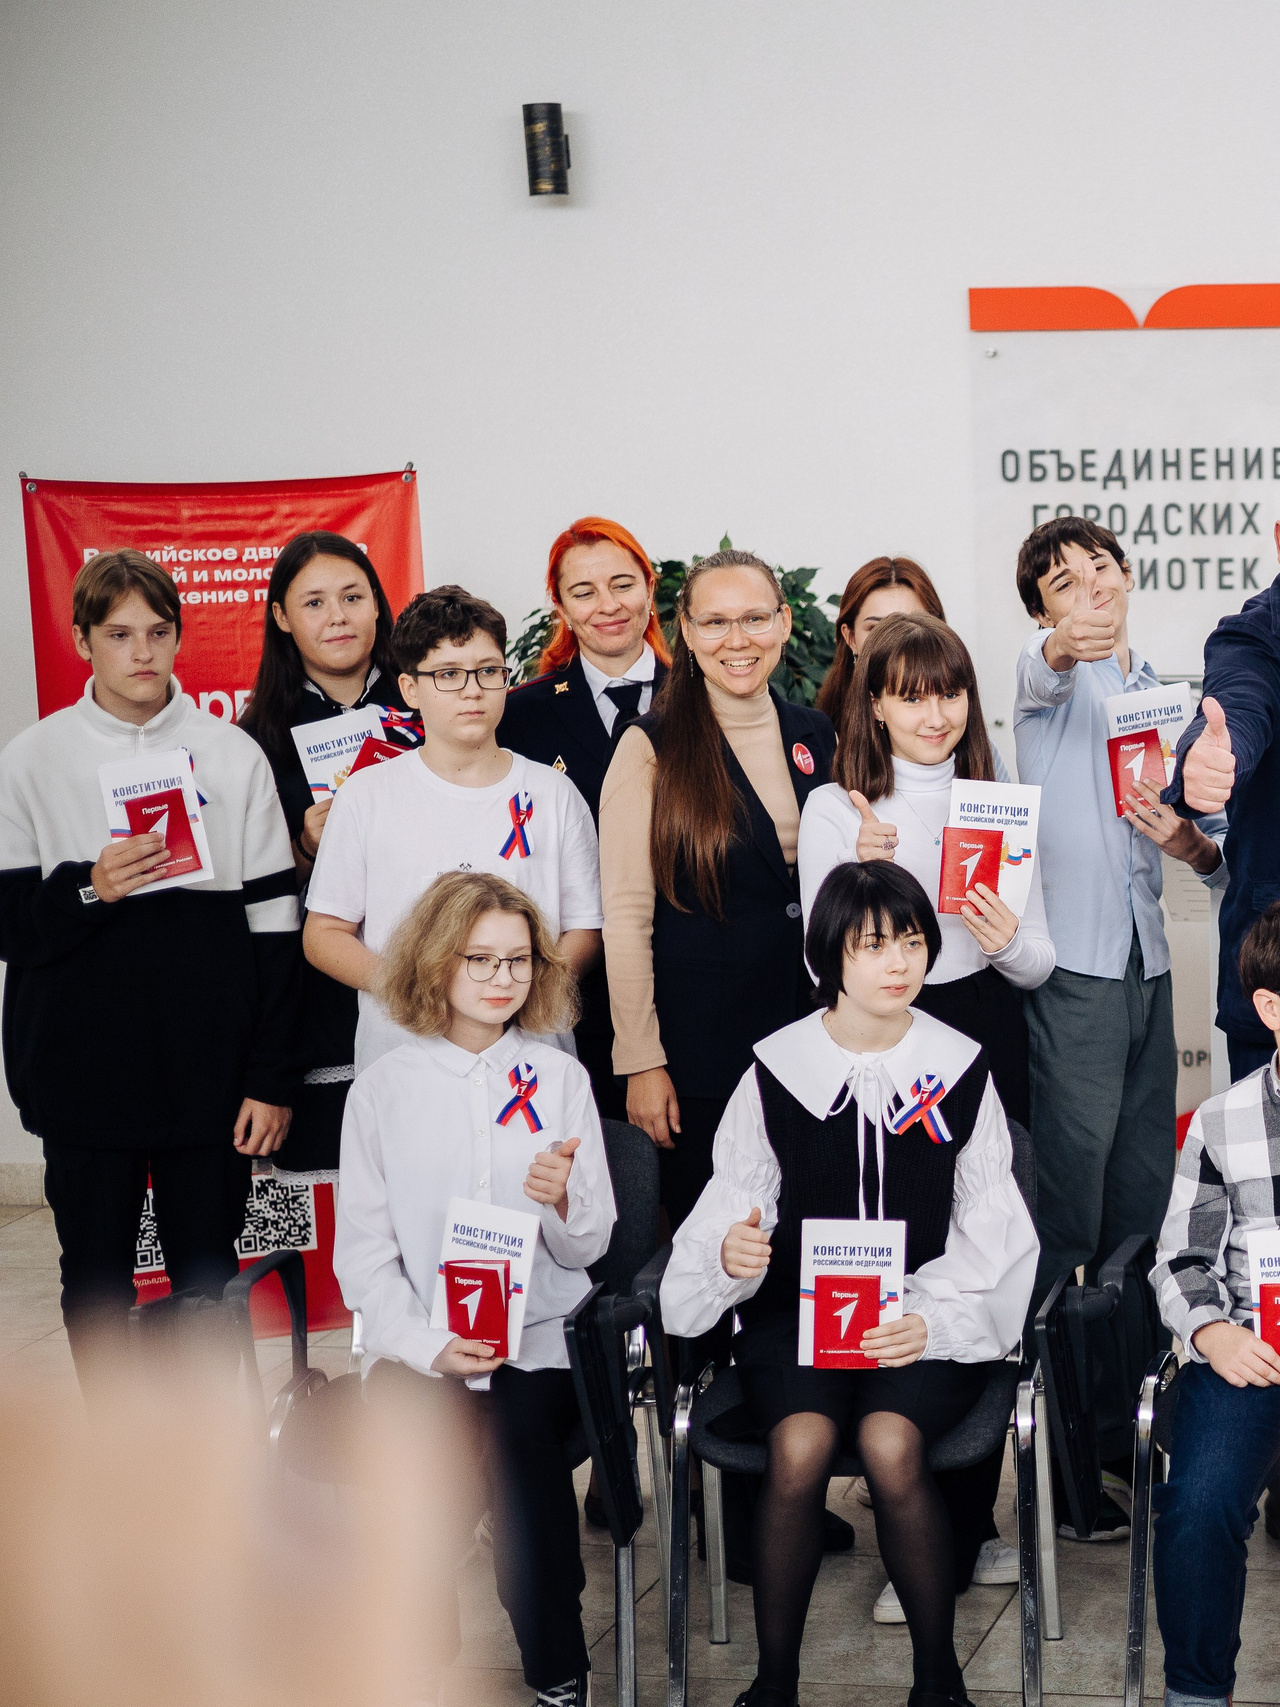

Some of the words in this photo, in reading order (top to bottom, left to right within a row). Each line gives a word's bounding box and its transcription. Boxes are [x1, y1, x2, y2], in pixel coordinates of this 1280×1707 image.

[83, 545, 238, 564] Рийское
[193, 570, 208, 583] и
[213, 567, 274, 582] моло
[1135, 557, 1260, 590] ИОТЕК
[1116, 704, 1183, 725] КОНСТИТУЦИЯ
[1118, 721, 1152, 733] РОССИЙСКОЙ
[1152, 715, 1184, 726] ФЕДЕРАЦИИ
[306, 729, 374, 756] КОНСТИТУЦИЯ
[112, 776, 183, 799] КОНСТИТУЦИЯ
[960, 802, 1029, 818] КОНСТИТУЦИЯ
[959, 815, 995, 824] РОССИЙСКОЙ
[996, 817, 1029, 827] ФЕДЕРАЦИИ
[959, 841, 984, 850] Первые
[453, 1223, 524, 1249] КОНСТИТУЦИЯ
[451, 1236, 488, 1251] РОССИЙСКОЙ
[488, 1245, 522, 1258] ФЕДЕРАЦИИ
[813, 1245, 893, 1259] КОНСТИТУЦИЯ
[812, 1258, 854, 1267] РОССИЙСКОЙ
[855, 1259, 892, 1268] ФЕДЕРАЦИИ
[454, 1276, 483, 1287] Первые
[831, 1291, 859, 1300] Первые
